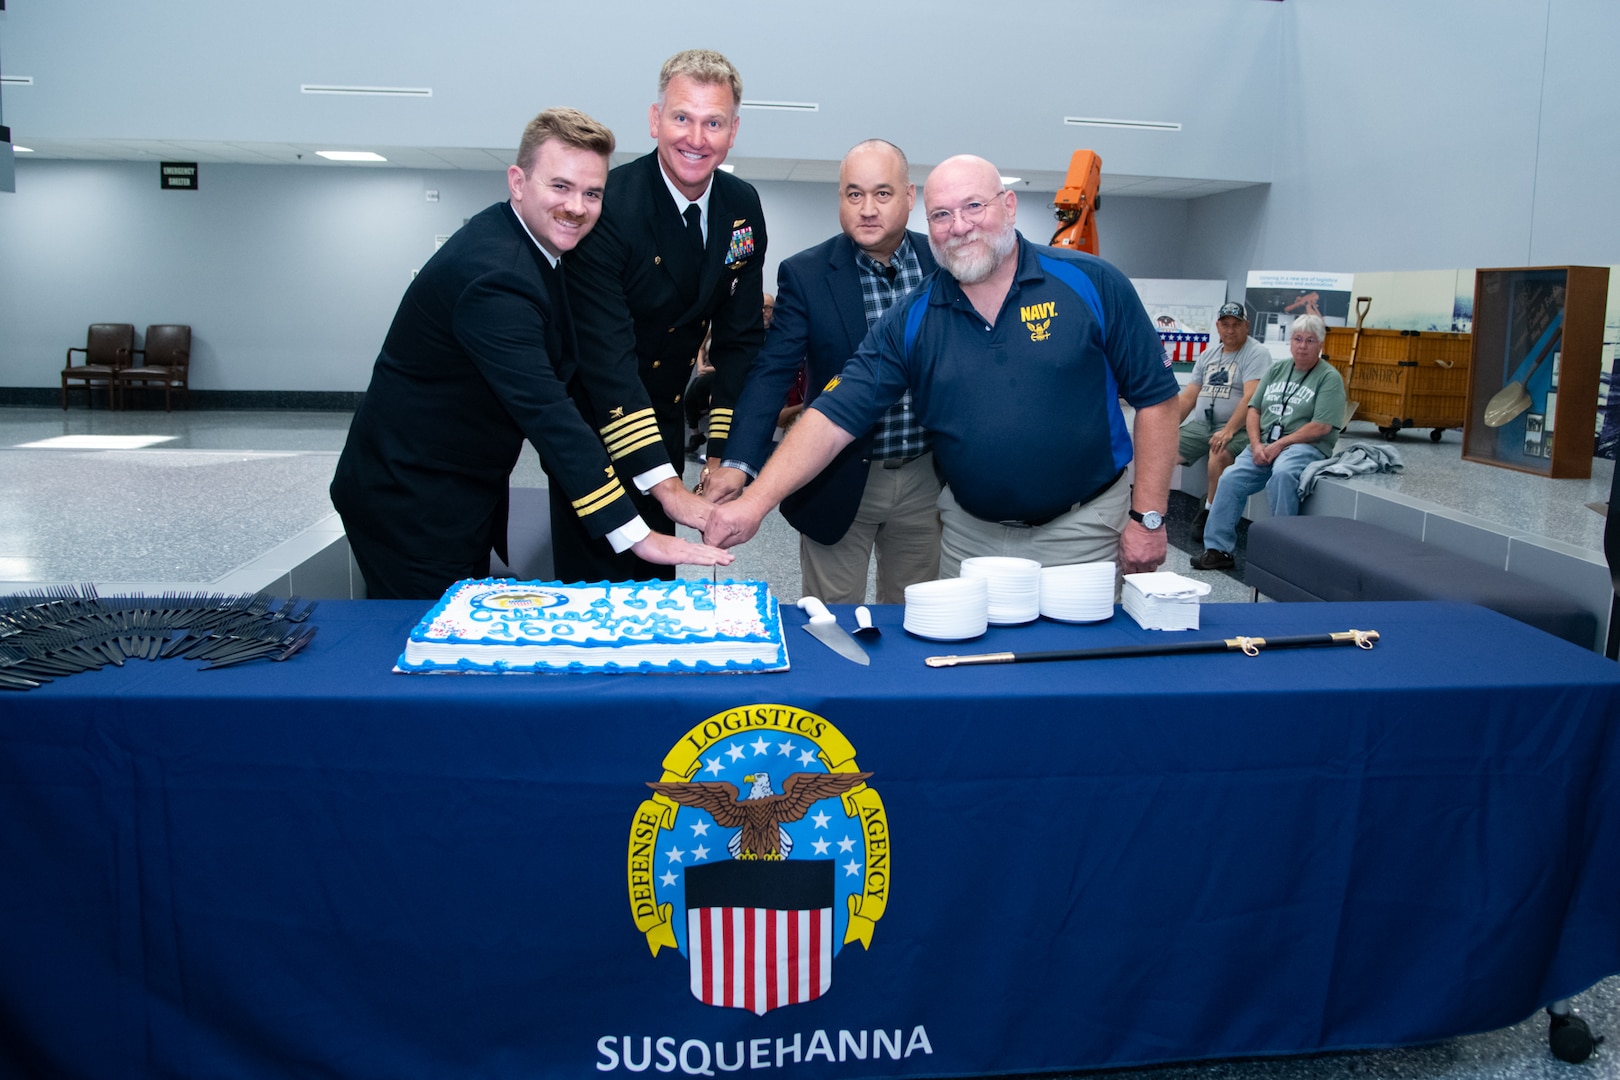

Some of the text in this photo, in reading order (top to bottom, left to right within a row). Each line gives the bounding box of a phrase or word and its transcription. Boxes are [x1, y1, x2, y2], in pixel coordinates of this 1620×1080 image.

[1354, 367, 1403, 384] AUNDRY
[687, 708, 827, 752] LOGISTICS
[632, 811, 659, 921] DEFENSE
[862, 805, 887, 902] AGENCY
[595, 1024, 934, 1077] SUSQUEHANNA
